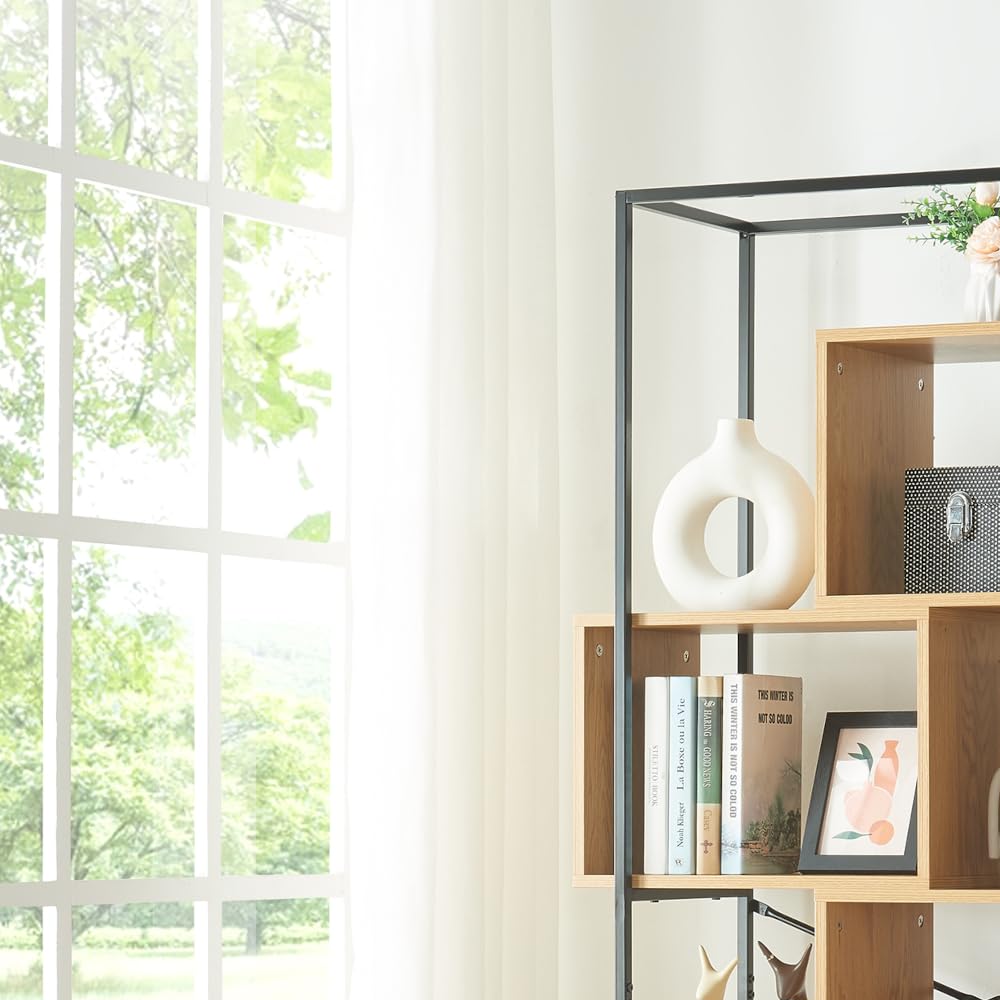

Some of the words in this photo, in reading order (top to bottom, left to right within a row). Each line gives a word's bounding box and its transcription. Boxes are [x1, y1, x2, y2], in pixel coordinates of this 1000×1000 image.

[729, 683, 738, 704] THIS
[757, 689, 769, 700] THIS
[769, 690, 788, 702] WINTER
[788, 691, 794, 702] IS
[677, 698, 686, 715] Vie
[677, 719, 685, 728] la
[729, 706, 738, 740] WINTER
[757, 712, 768, 724] NOT
[768, 713, 776, 724] SO
[679, 731, 685, 744] ou
[729, 742, 738, 751] IS
[676, 747, 685, 773] Boxe
[729, 754, 738, 772] NOT
[676, 777, 685, 790] La
[729, 774, 738, 786] SO
